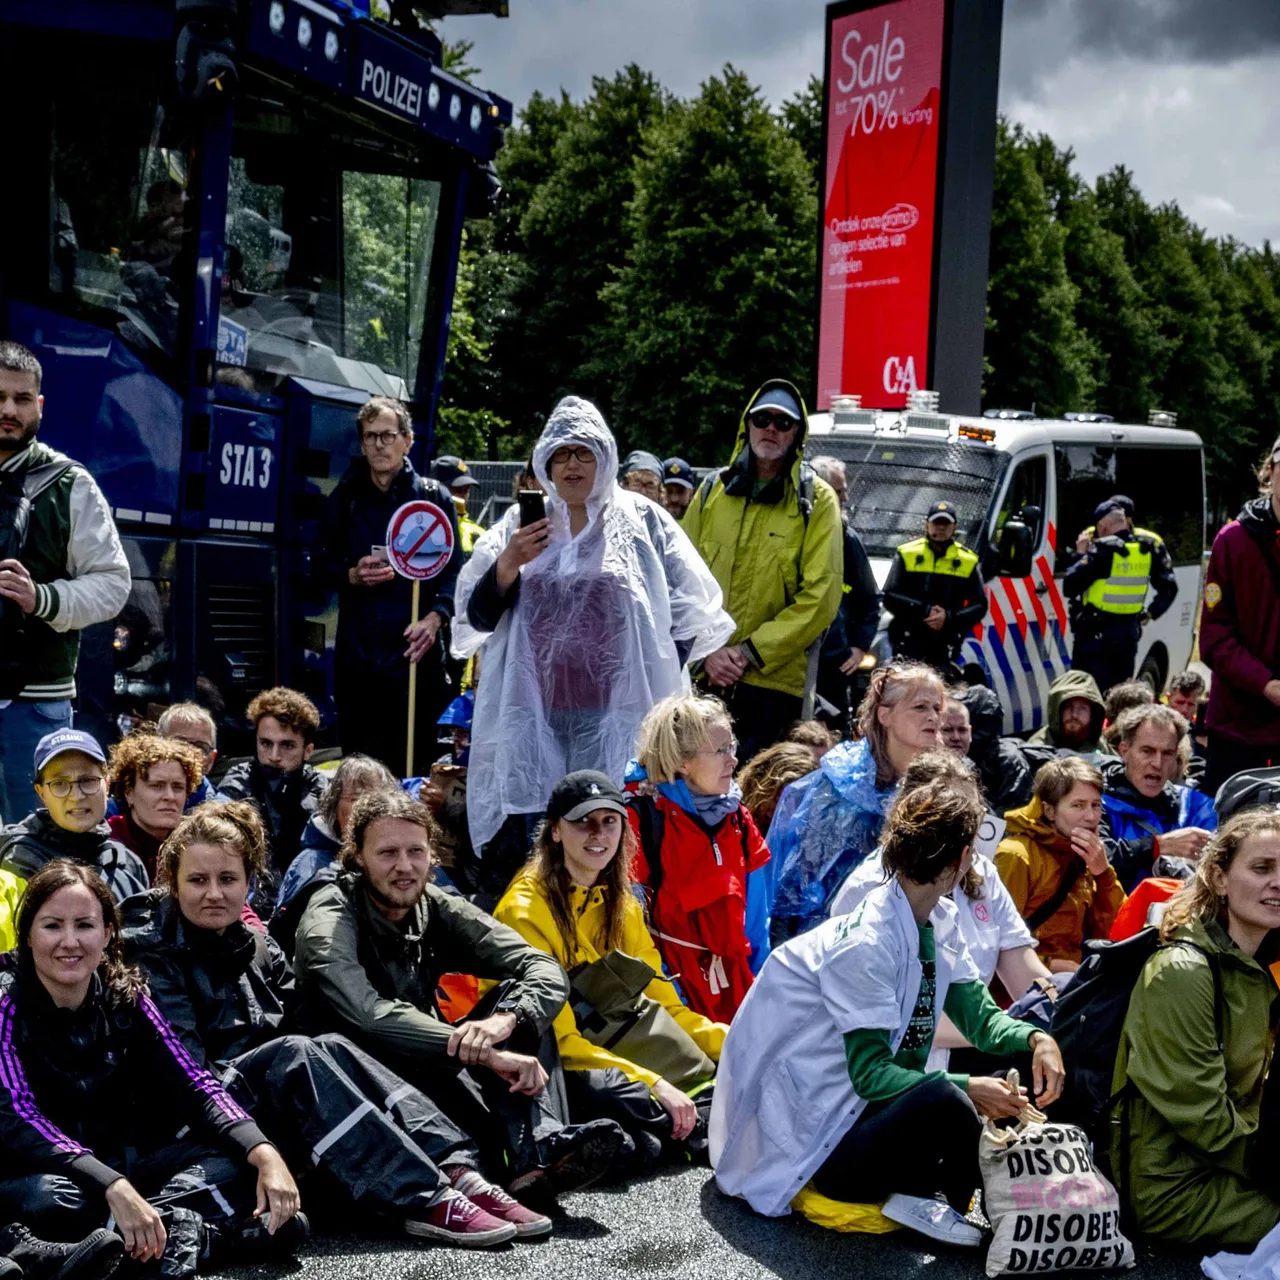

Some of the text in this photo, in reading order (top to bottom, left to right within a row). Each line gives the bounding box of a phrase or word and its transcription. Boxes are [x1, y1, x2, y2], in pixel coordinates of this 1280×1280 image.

[837, 20, 905, 93] Sale
[361, 59, 423, 117] POLIZEI
[831, 215, 860, 234] Ontdek
[883, 355, 918, 394] C&A
[220, 442, 272, 489] STA 3
[1006, 1242, 1125, 1272] DISOBEY
